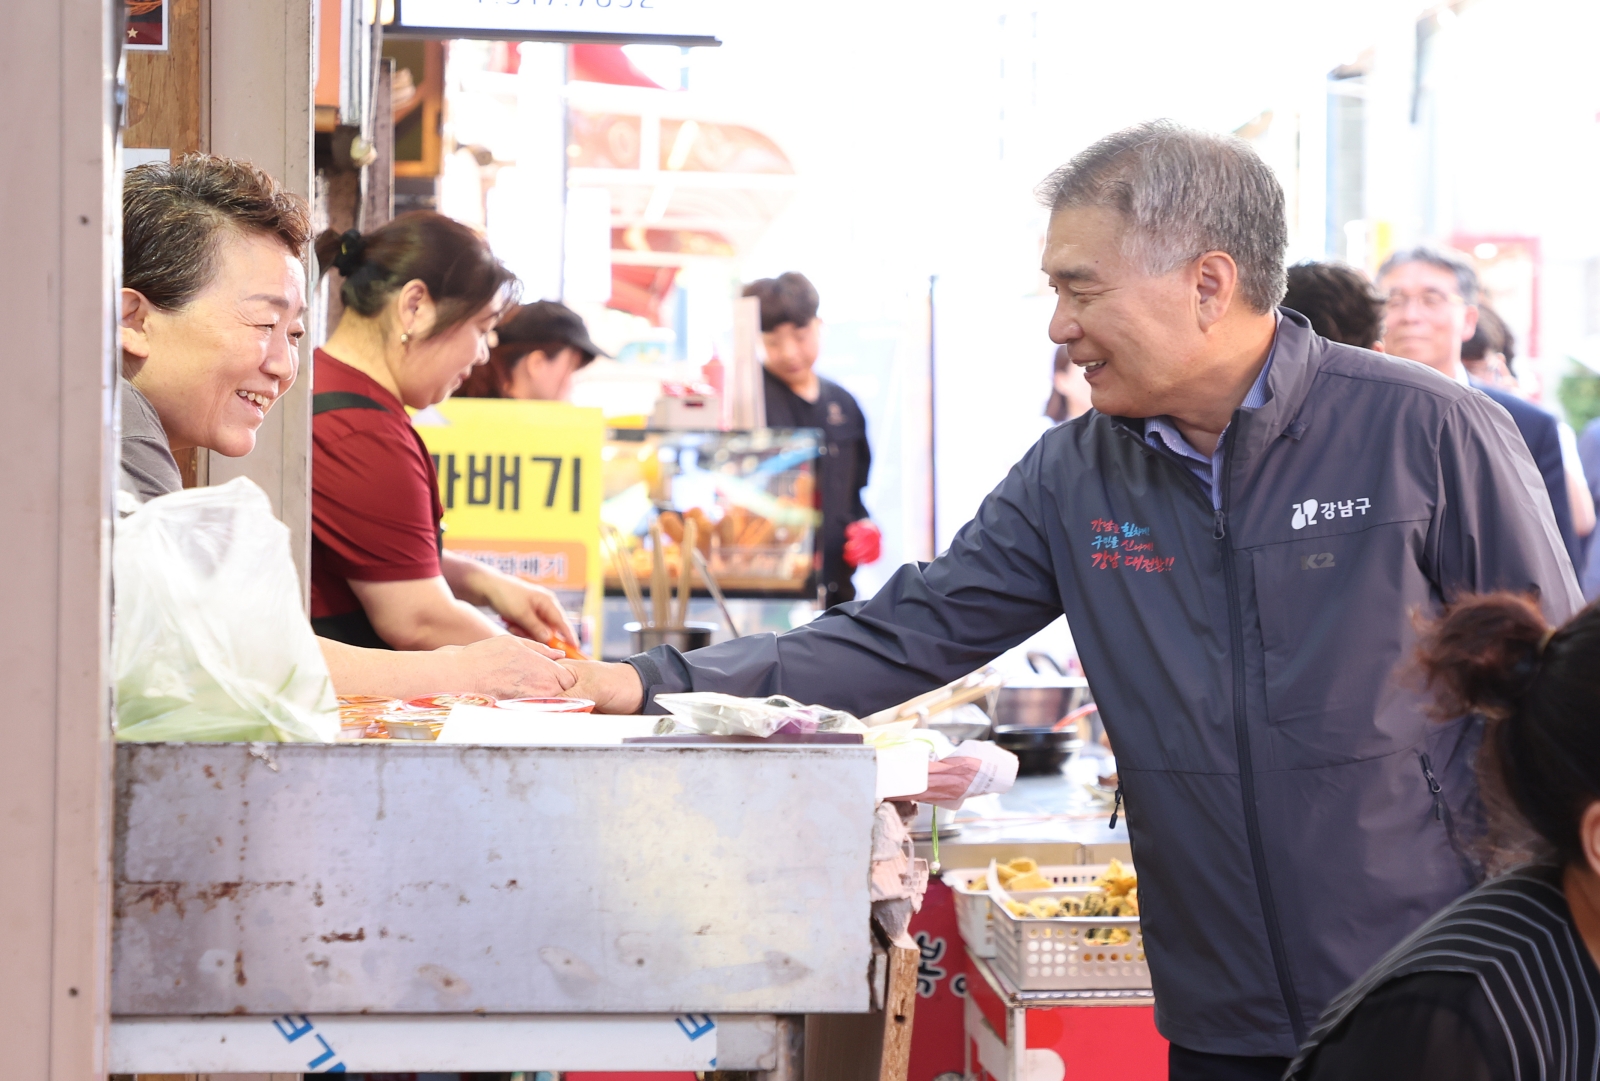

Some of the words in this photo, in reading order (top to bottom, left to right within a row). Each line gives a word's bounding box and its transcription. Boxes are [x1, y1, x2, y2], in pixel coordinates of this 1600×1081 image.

[1320, 497, 1371, 520] 강남구
[1091, 535, 1118, 549] 구민을
[1091, 550, 1121, 570] 강남
[1301, 552, 1335, 570] K2
